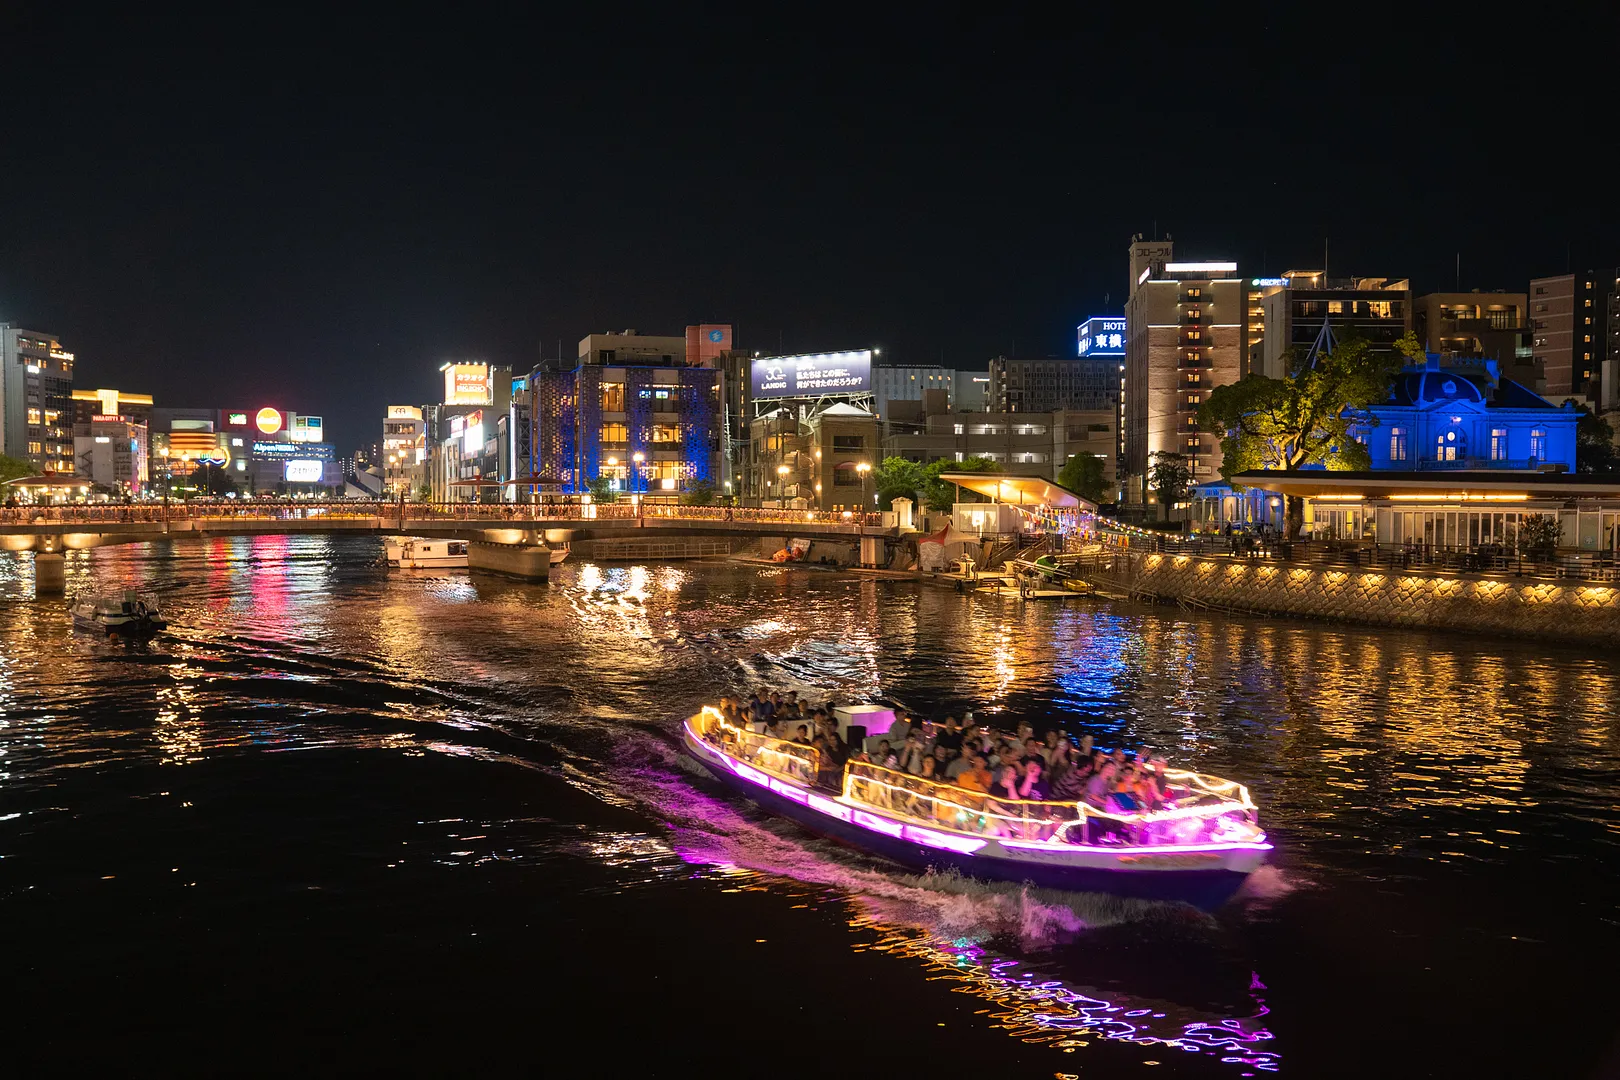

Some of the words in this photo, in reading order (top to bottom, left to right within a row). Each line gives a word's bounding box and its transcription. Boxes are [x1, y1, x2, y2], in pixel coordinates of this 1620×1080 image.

[1136, 247, 1172, 257] フローラル
[761, 381, 787, 390] LANDIC
[253, 443, 276, 453] Alpen
